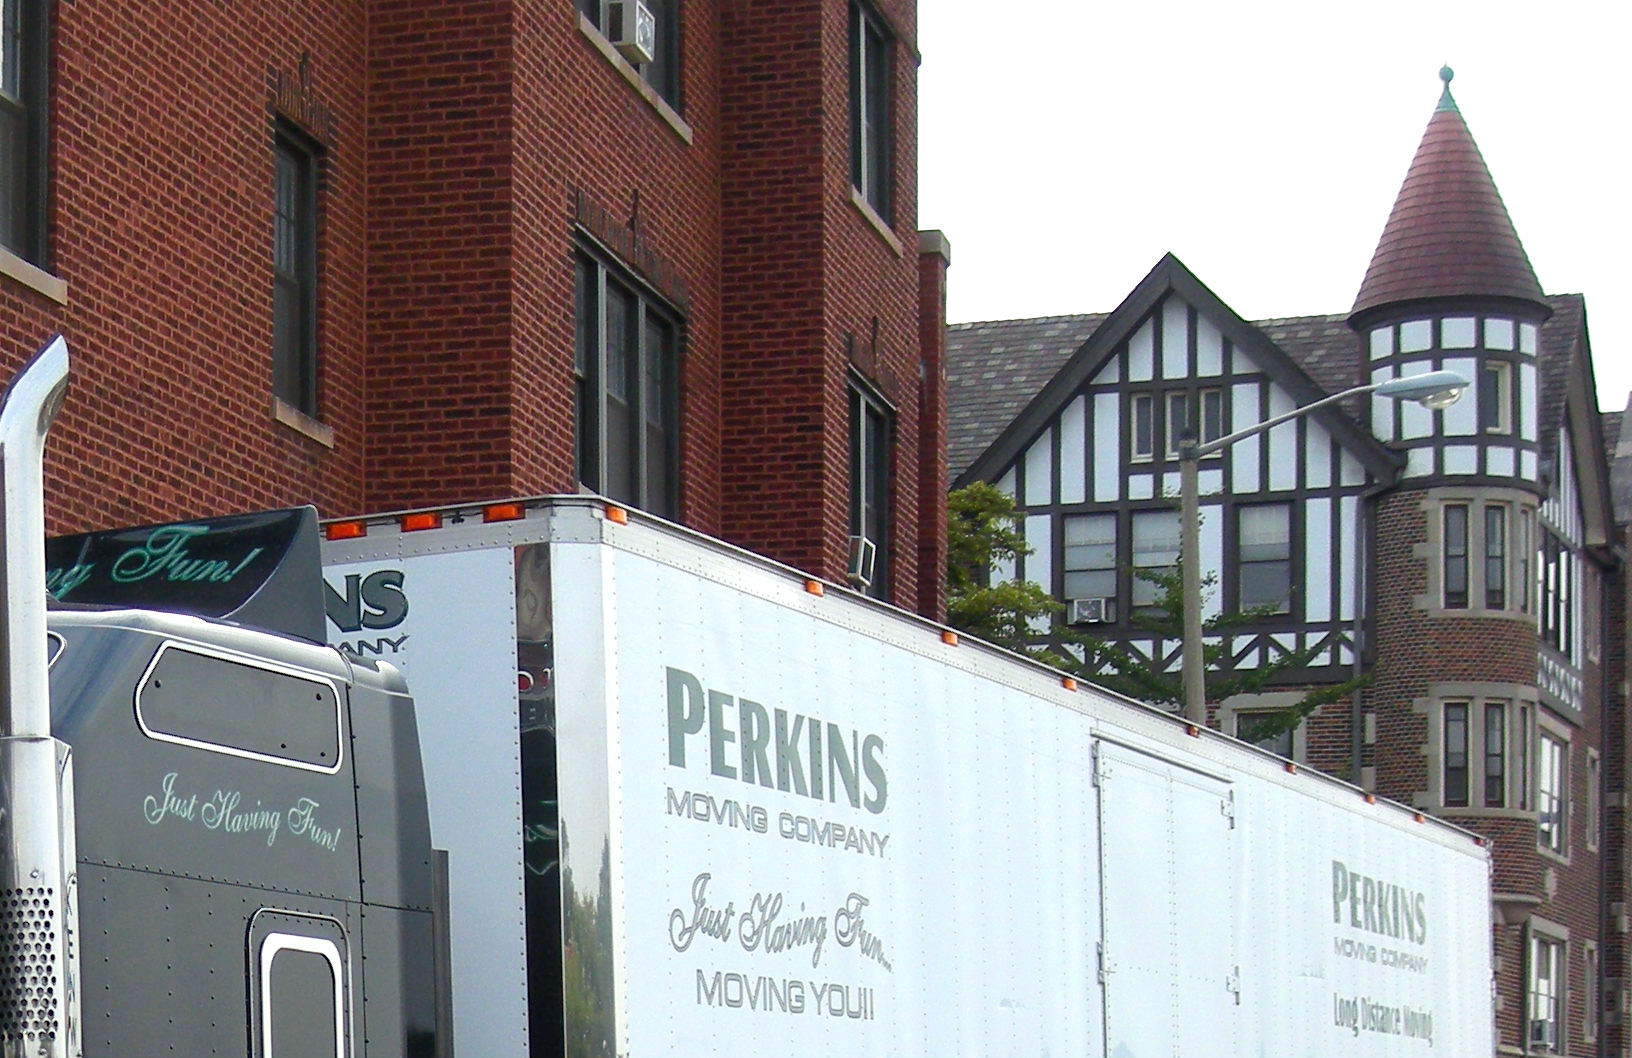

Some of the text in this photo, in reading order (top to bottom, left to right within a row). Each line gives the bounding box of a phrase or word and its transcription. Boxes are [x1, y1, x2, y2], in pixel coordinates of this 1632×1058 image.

[112, 525, 264, 583] Fun!
[666, 666, 887, 815] PERKINS
[143, 772, 342, 852] Just Having Fun!
[666, 786, 891, 859] MOVING COMPANY
[669, 872, 736, 953] Just
[738, 892, 828, 969] Having
[1331, 859, 1427, 946] PERKINS
[696, 968, 806, 1014] MOVING
[1334, 936, 1429, 975] MOVING COMPANY
[1333, 992, 1433, 1048] Long Distance Moving
